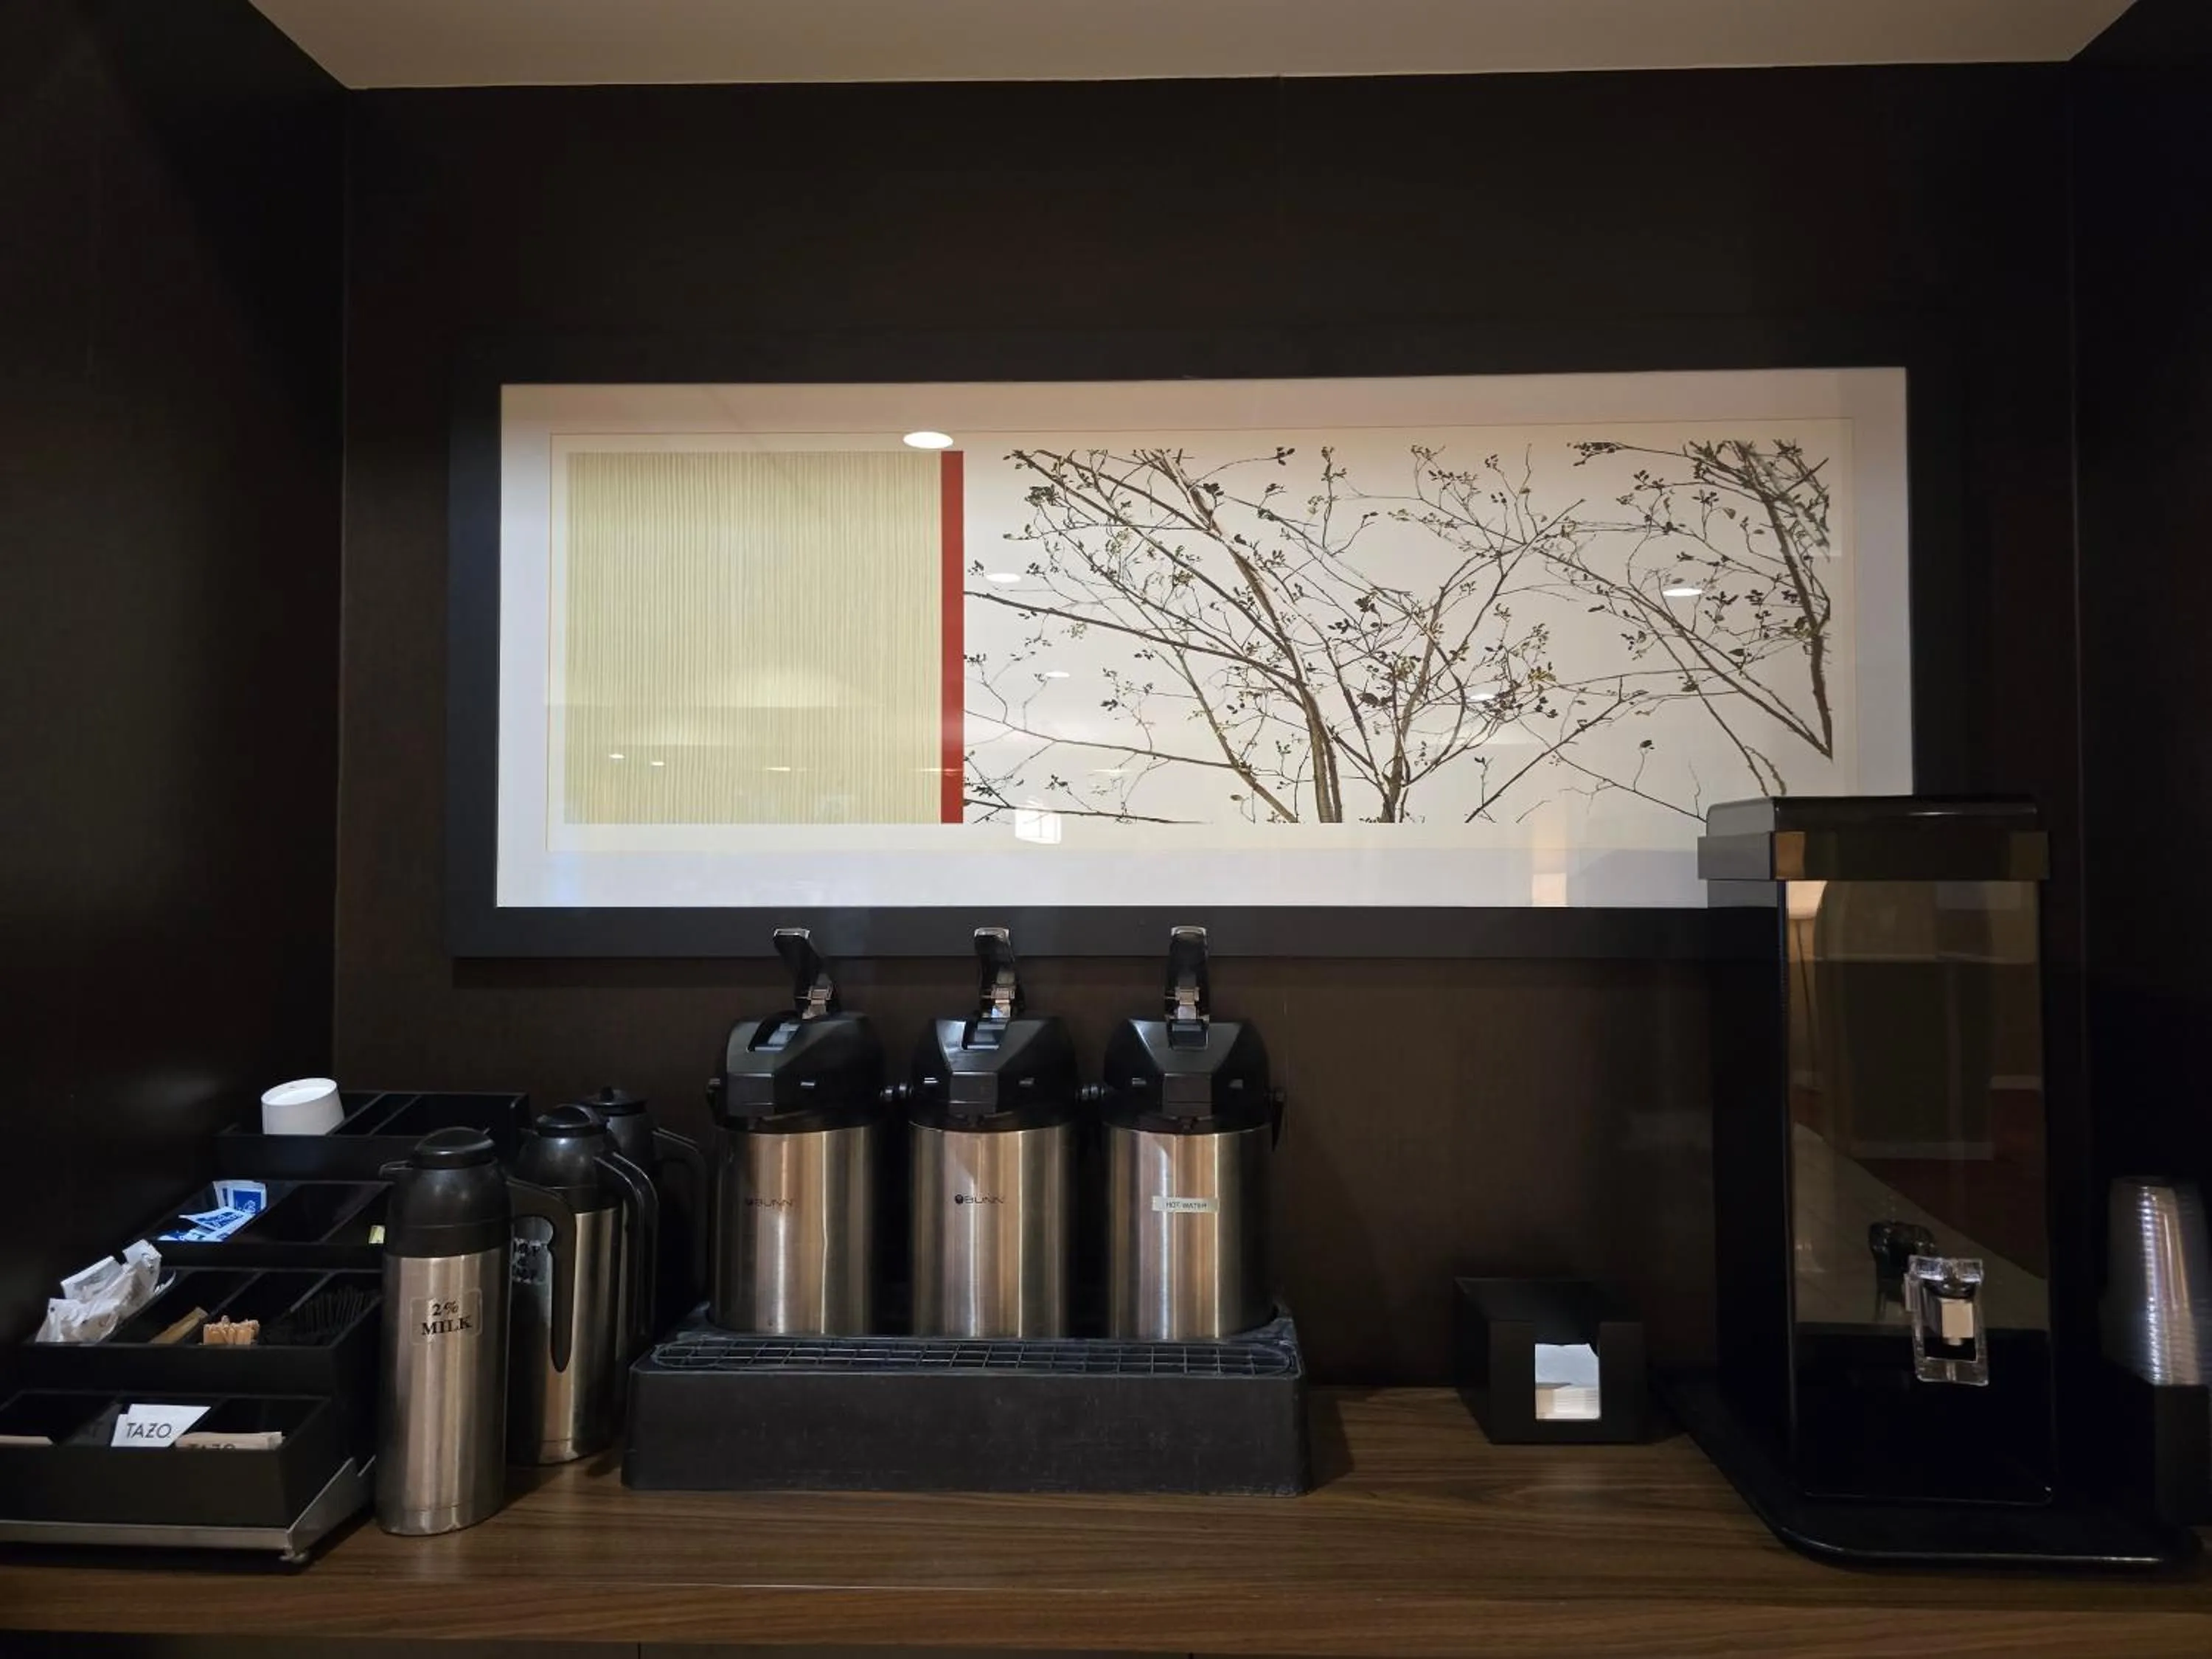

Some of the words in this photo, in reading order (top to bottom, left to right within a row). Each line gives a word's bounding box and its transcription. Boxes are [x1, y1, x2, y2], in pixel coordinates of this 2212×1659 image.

[964, 1194, 1004, 1204] BUNN
[432, 1301, 459, 1315] 2%
[421, 1315, 473, 1335] MILK
[126, 1422, 172, 1439] TAZO
